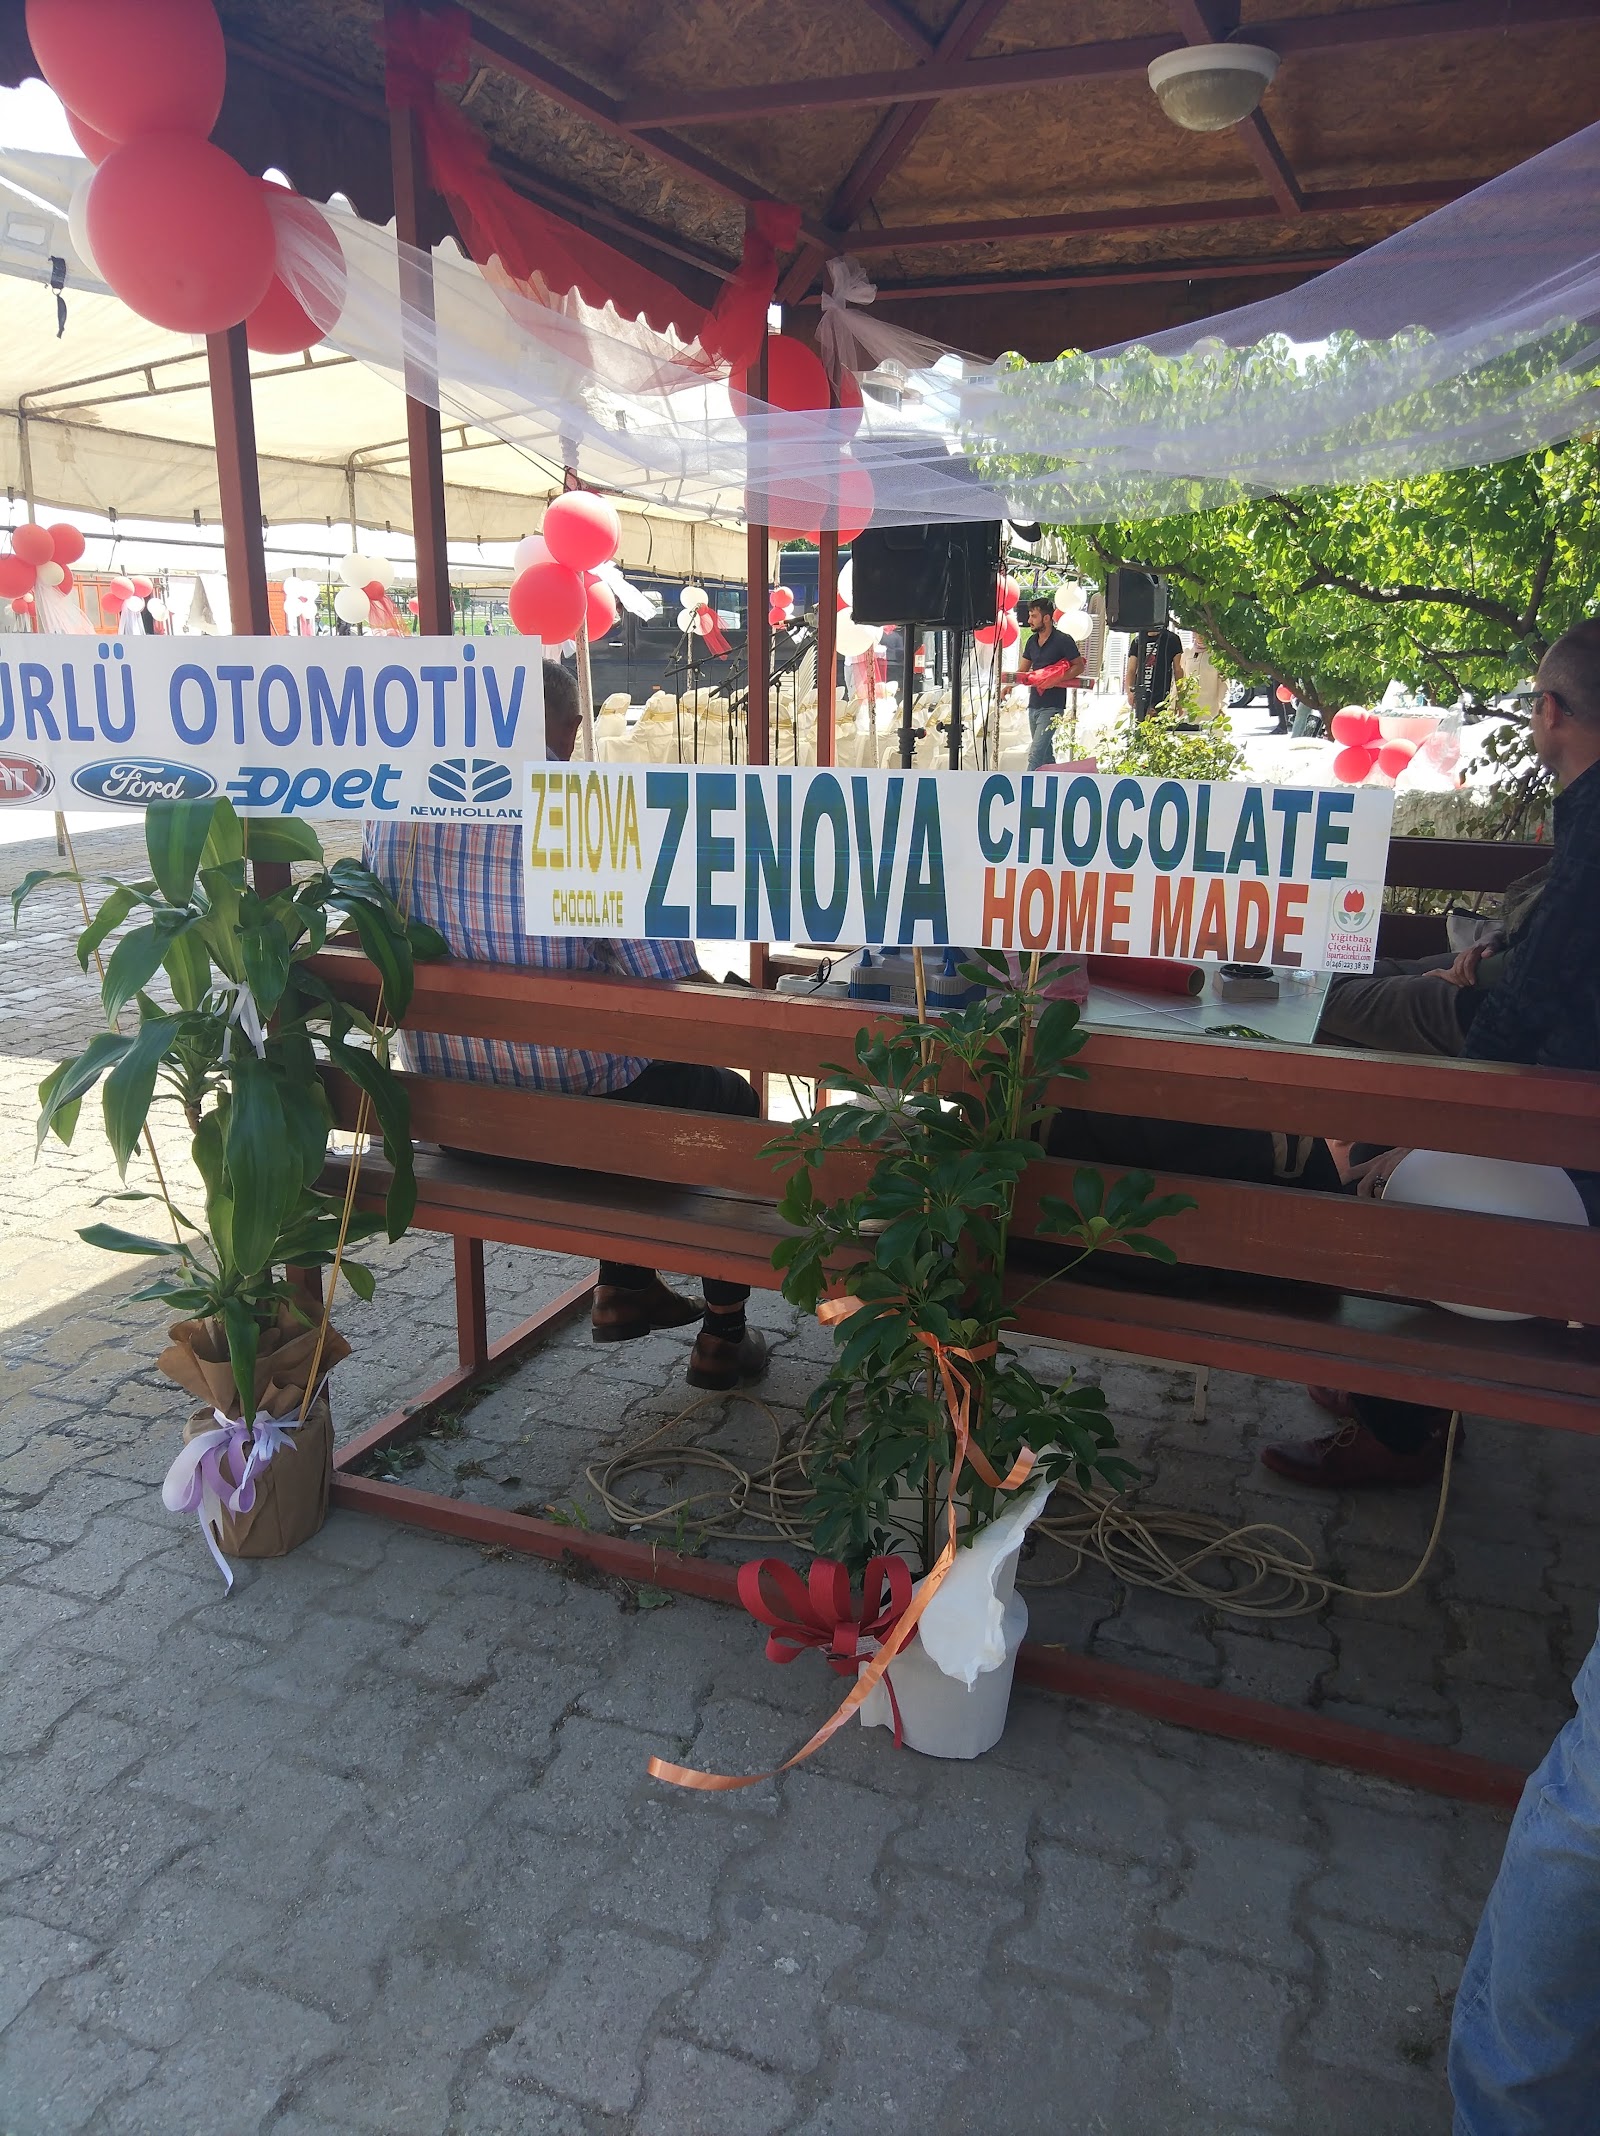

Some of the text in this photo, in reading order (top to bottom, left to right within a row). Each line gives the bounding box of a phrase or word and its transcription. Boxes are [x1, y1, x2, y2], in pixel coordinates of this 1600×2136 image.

[170, 644, 526, 748] OTOMOTİV
[101, 764, 186, 800] Ford
[411, 806, 447, 816] NEW
[644, 772, 1355, 945] ZENOVA CHOCOLATE
[553, 889, 623, 926] CHOCOLATE
[981, 867, 1309, 967] HOME MADE
[1327, 942, 1372, 953] Çiçekçilik
[1331, 933, 1372, 945] Yiğitbaşı
